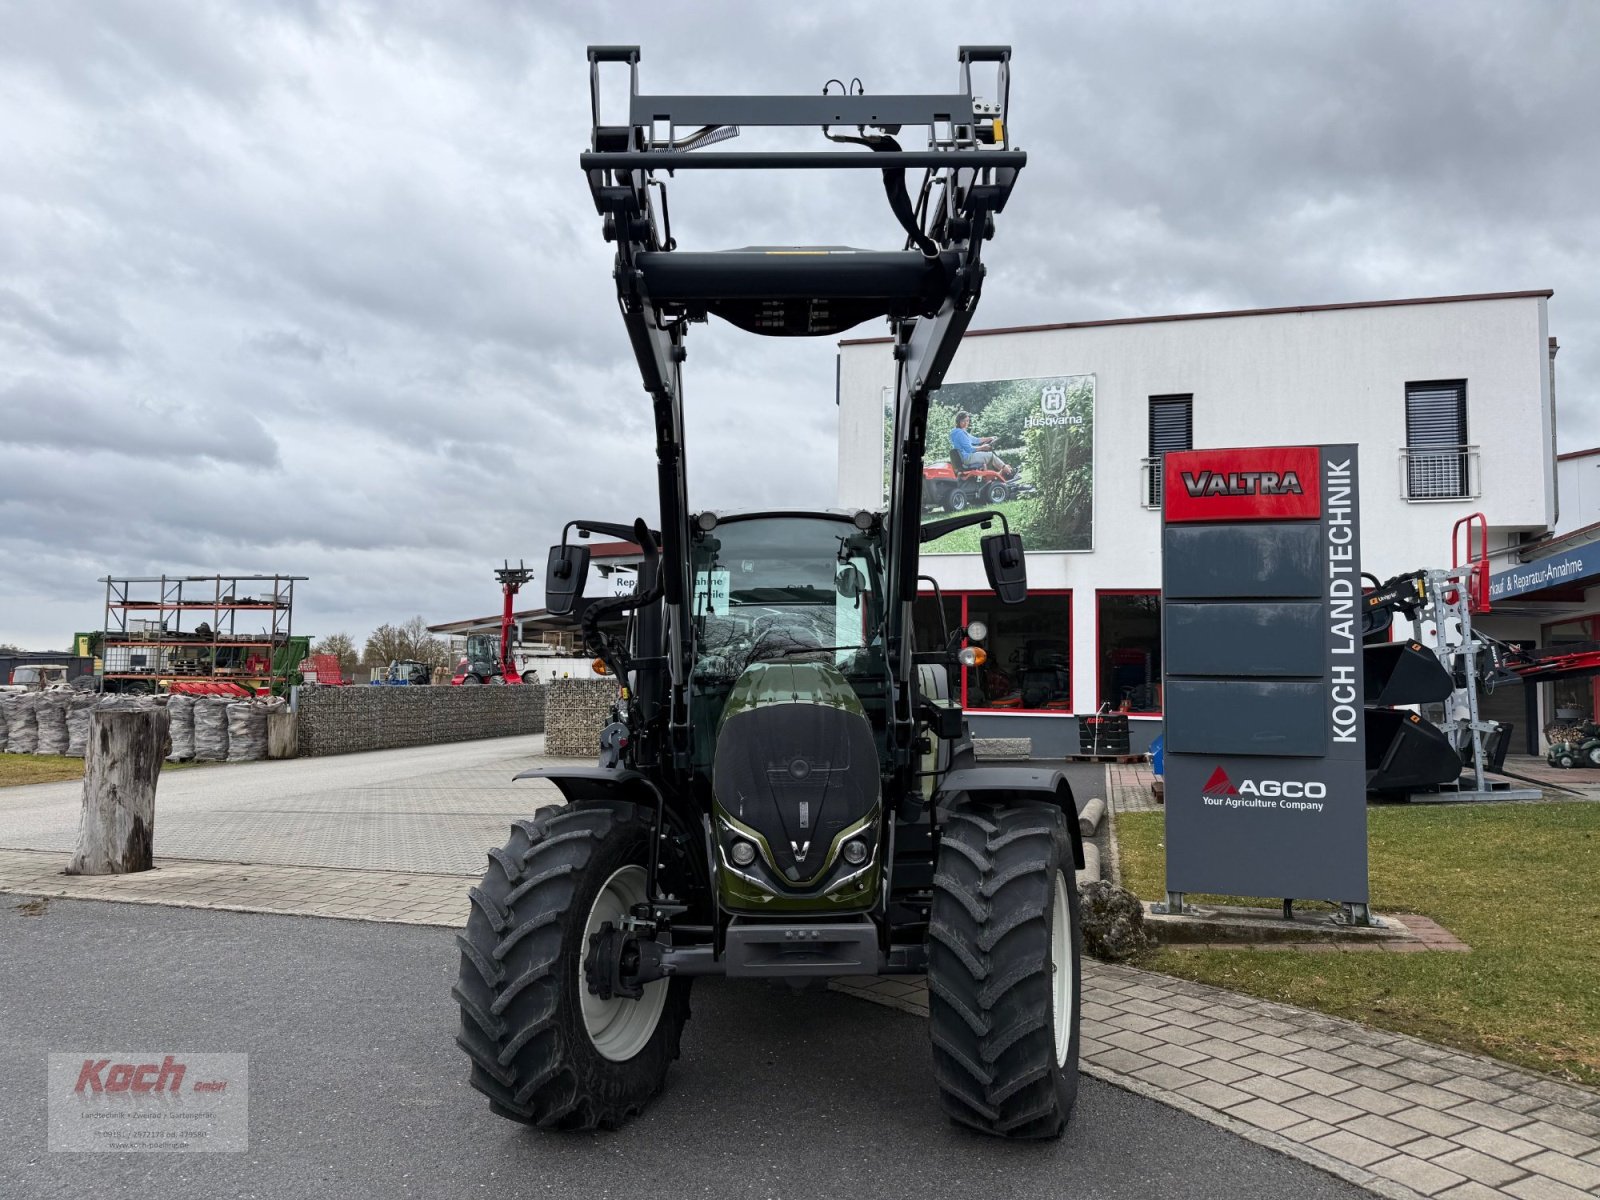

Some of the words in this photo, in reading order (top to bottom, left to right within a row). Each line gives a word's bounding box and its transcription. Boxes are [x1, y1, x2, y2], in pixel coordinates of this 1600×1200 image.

[1024, 415, 1083, 428] Husqvarna
[1181, 471, 1304, 497] VALTRA
[1327, 458, 1355, 654] LANDTECHNIK
[1506, 576, 1513, 591] &
[1513, 559, 1583, 592] Reparatur-Annahme
[1331, 666, 1357, 743] KOCH
[1238, 780, 1327, 798] AGCO
[1202, 797, 1223, 806] Your
[1225, 798, 1277, 809] Agriculture
[1279, 800, 1324, 812] Company
